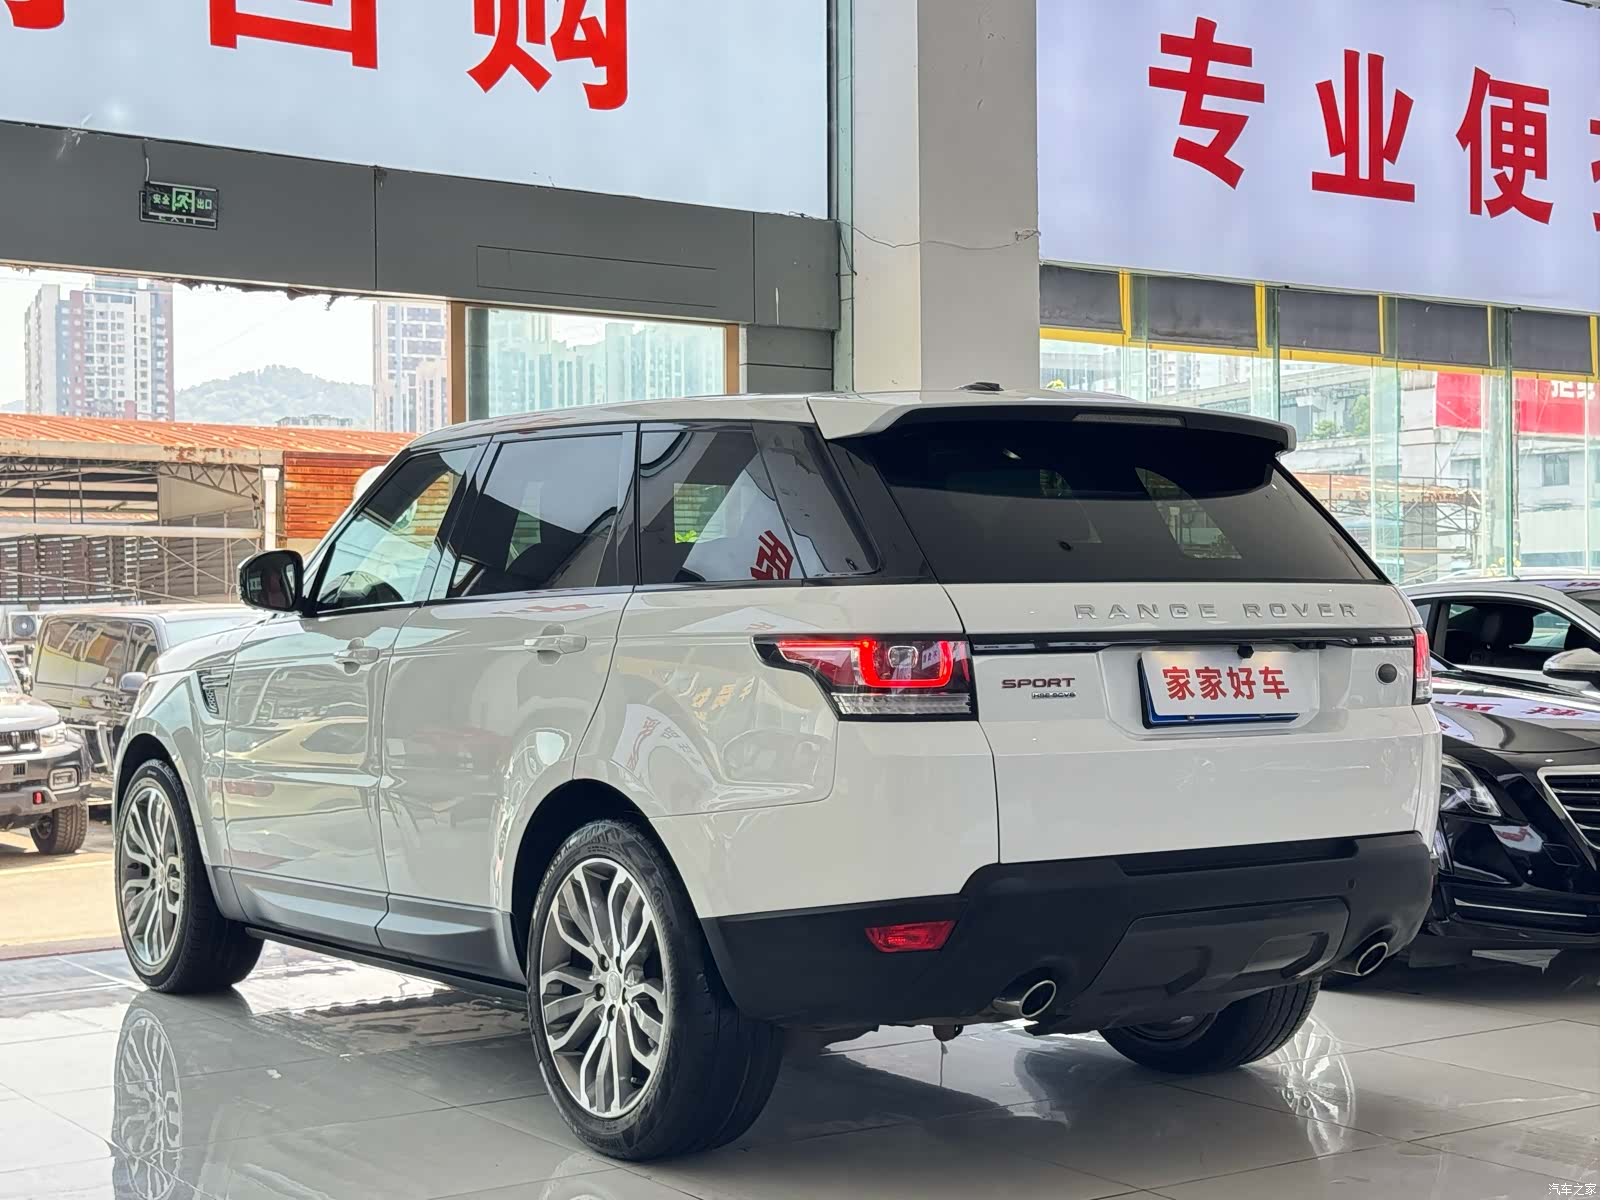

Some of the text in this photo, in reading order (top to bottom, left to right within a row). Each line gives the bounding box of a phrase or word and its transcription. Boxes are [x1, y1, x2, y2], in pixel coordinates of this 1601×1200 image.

[1149, 17, 1600, 231] 专业便
[152, 193, 213, 210] 安全 出口
[1074, 602, 1358, 620] RANGE ROVER
[1001, 677, 1076, 689] SPORT
[1162, 666, 1290, 701] 家家好车
